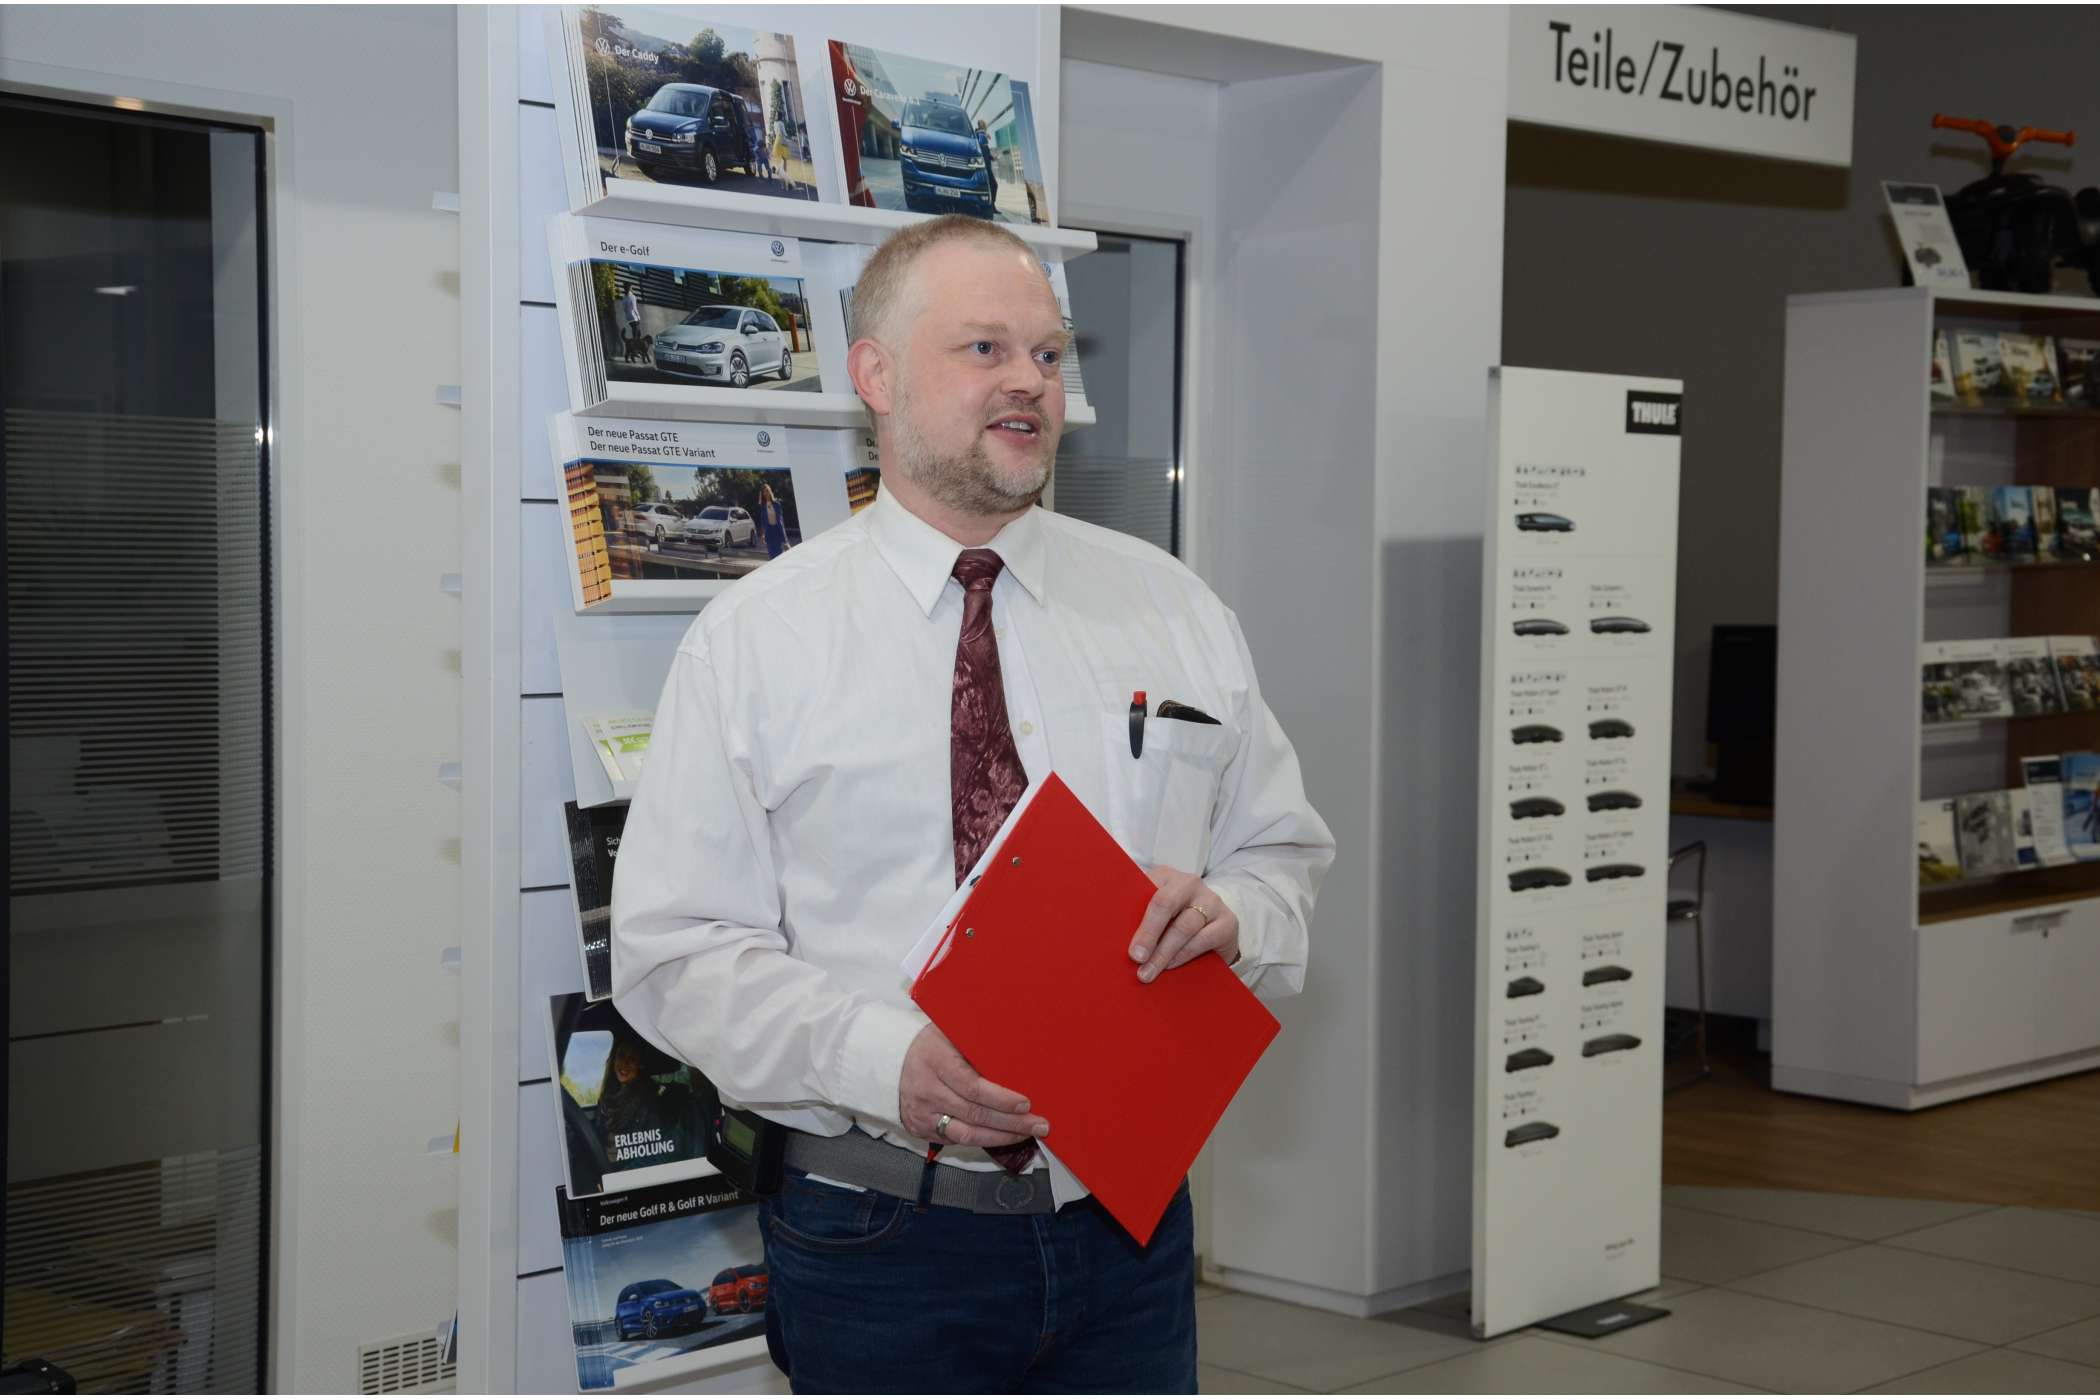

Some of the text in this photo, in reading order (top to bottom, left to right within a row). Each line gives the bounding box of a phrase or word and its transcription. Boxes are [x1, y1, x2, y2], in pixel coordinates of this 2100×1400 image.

[614, 44, 659, 65] Der Caddy
[1549, 21, 1816, 122] Teile/Zubehör
[600, 241, 650, 257] Der e-Golf
[1631, 401, 1678, 425] THULE
[587, 426, 679, 443] Der neue Passat GTE
[590, 440, 716, 458] Der neue Passat GTE Variant
[614, 1128, 662, 1148] ERLEBNIS
[616, 1139, 675, 1161] ABHOLUNG
[600, 1190, 740, 1226] Der neue Golf R & Golf R Variant
